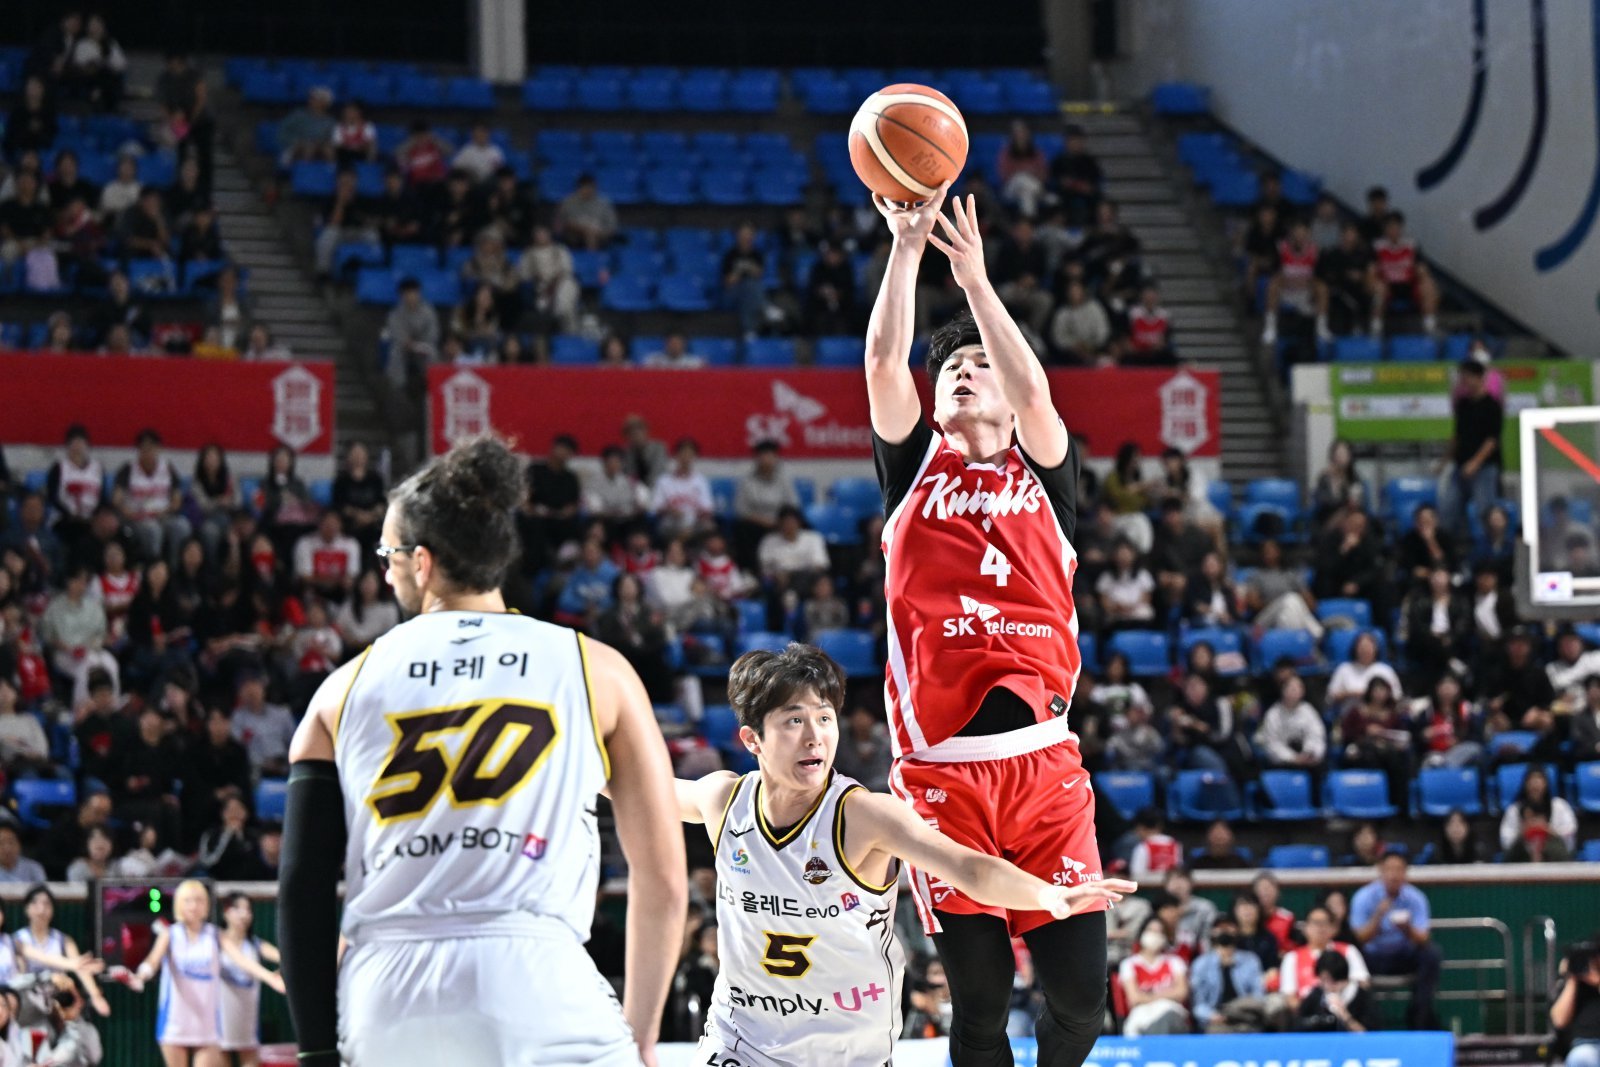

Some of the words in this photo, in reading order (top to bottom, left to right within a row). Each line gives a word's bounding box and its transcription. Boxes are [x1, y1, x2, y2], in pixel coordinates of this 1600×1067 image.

[921, 470, 1045, 533] Knights
[980, 542, 1012, 587] 4
[943, 616, 976, 637] SK
[984, 616, 1052, 638] telecom
[364, 697, 561, 827] 50
[1053, 870, 1073, 886] SK
[719, 880, 736, 905] LG
[741, 891, 802, 917] 올레드
[806, 904, 840, 918] evo
[759, 930, 819, 979] 5
[833, 983, 885, 1012] U+
